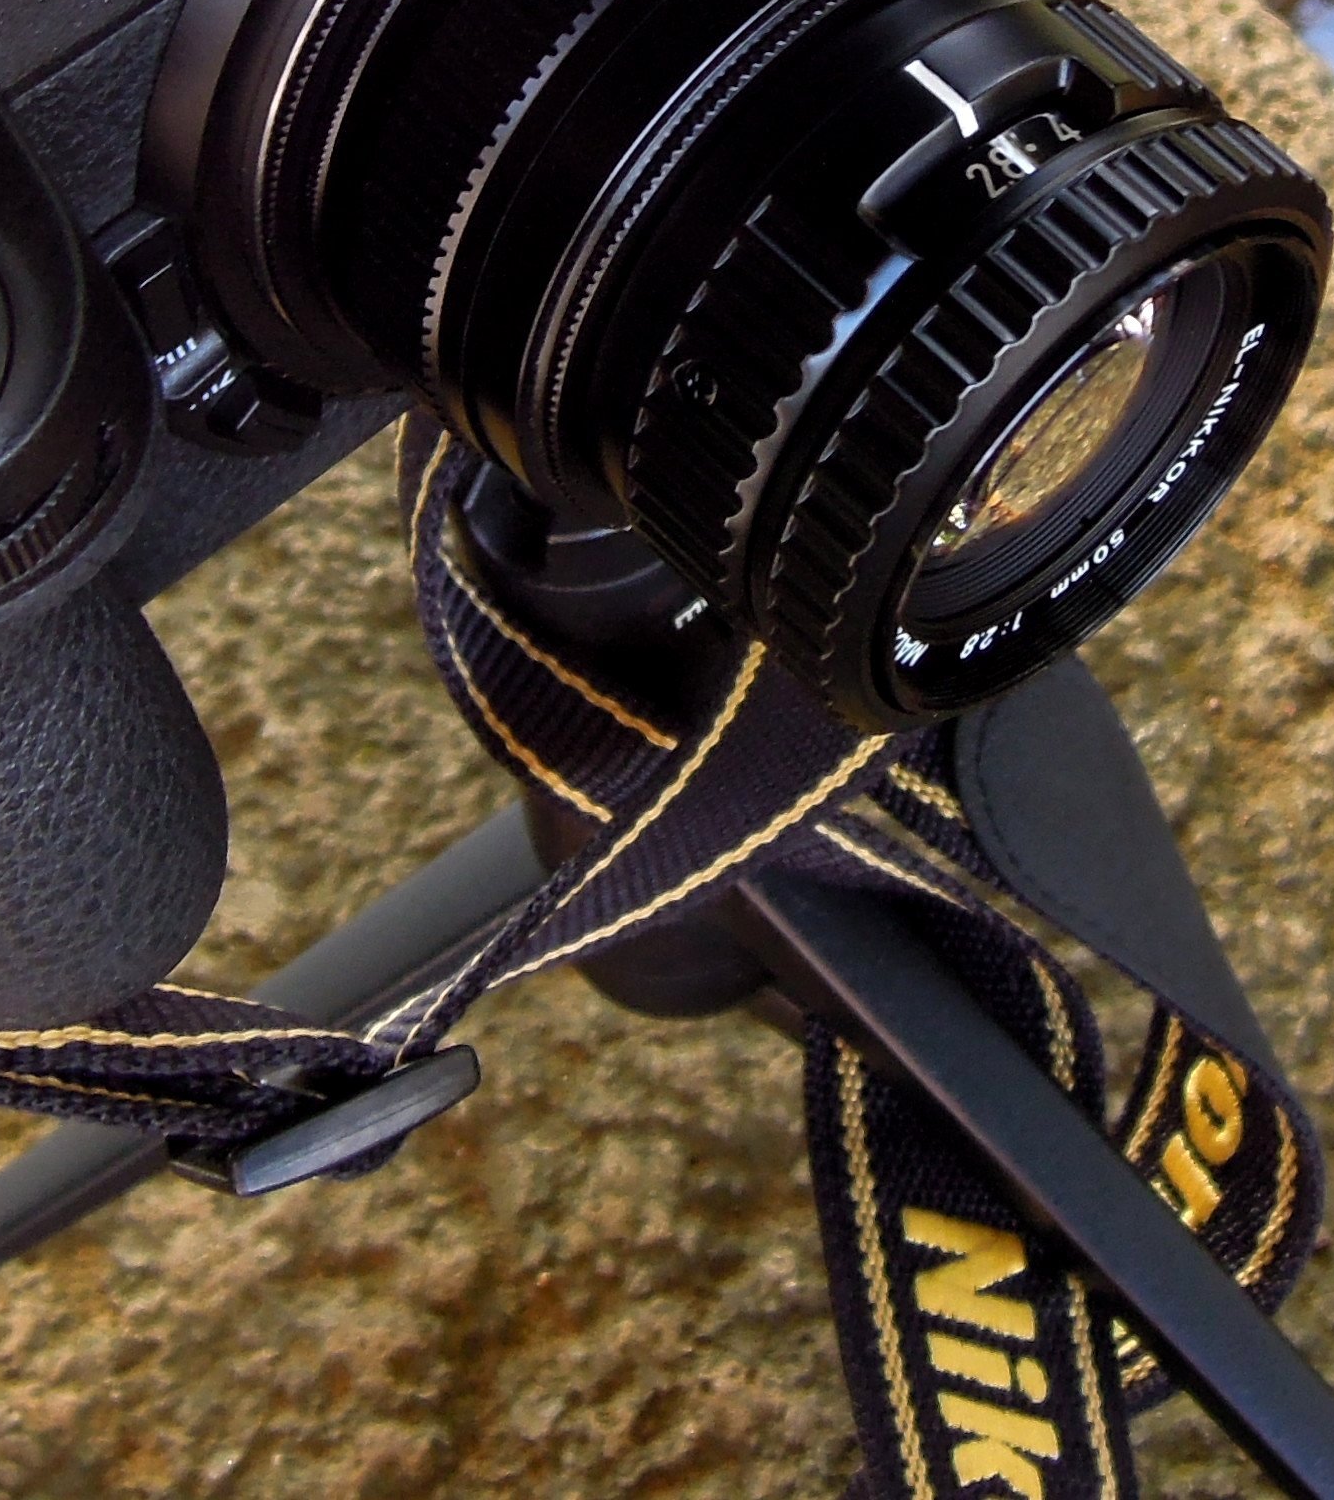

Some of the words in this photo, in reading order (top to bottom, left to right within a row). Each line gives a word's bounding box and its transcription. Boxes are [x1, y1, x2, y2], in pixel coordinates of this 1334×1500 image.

[1148, 322, 1266, 504] EL-NIKKOR
[1050, 527, 1127, 601] 50mm
[960, 611, 1026, 661] 1:2.8
[901, 1206, 1061, 1500] Nik
